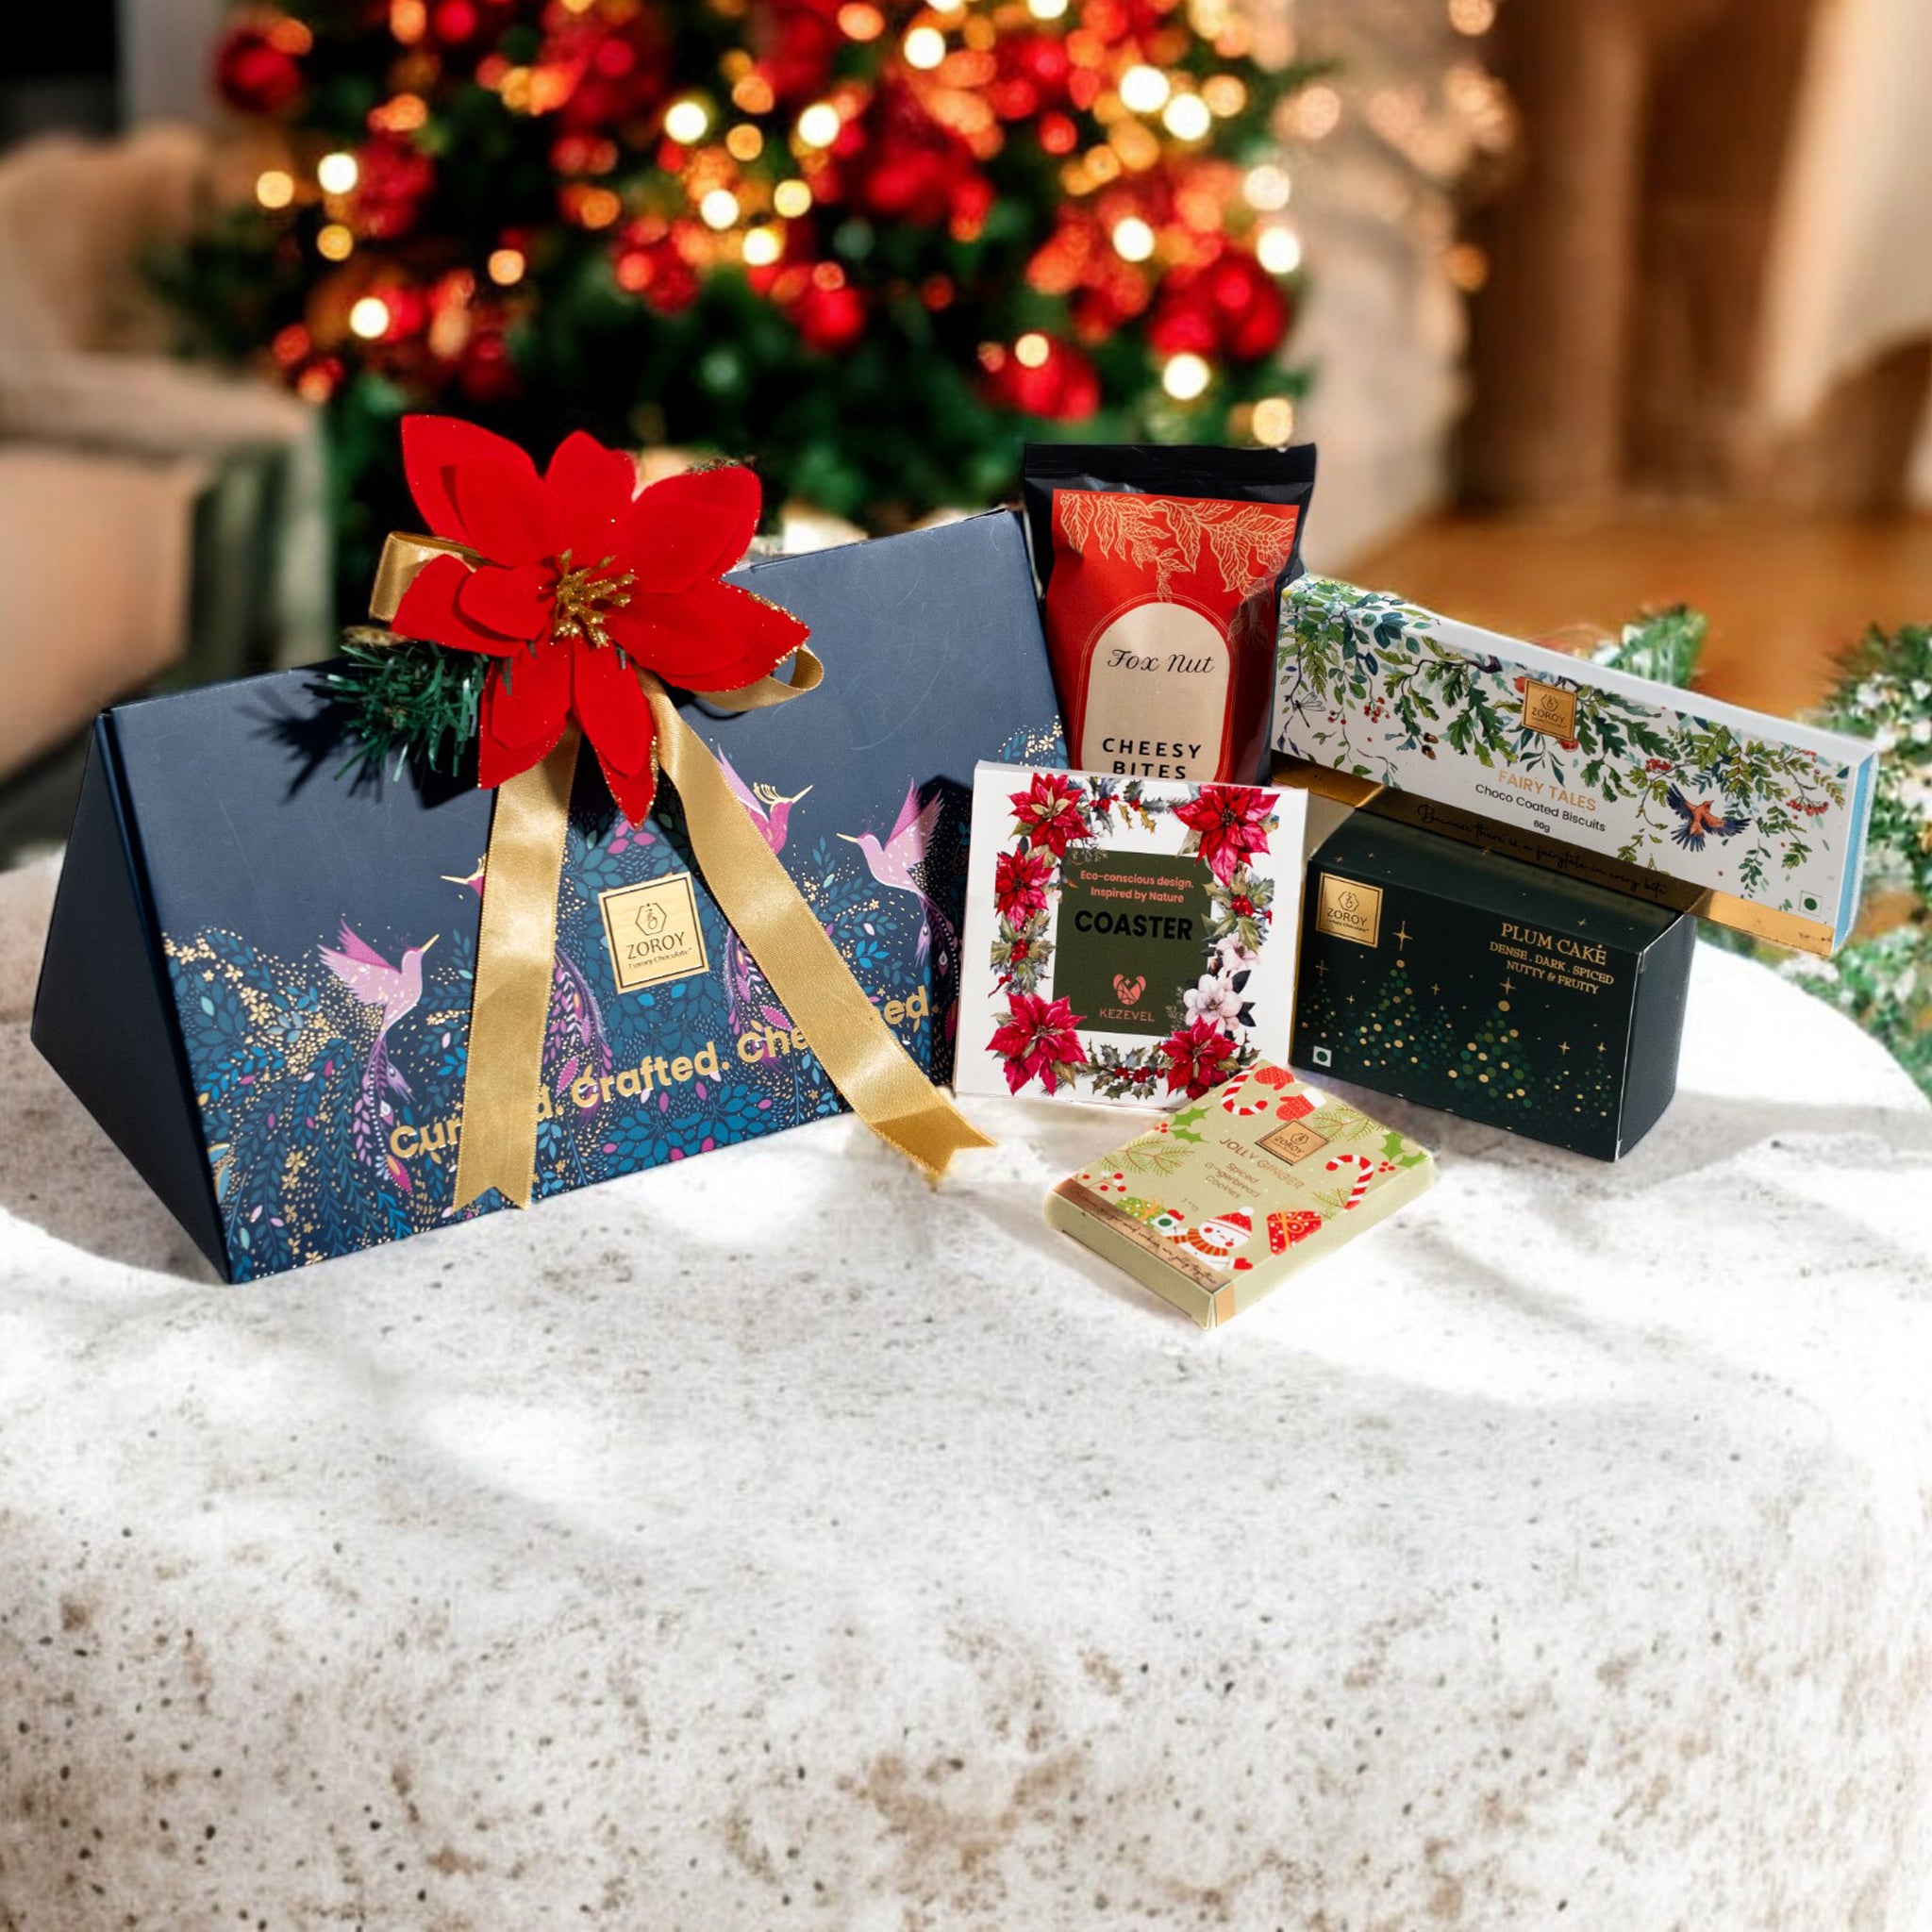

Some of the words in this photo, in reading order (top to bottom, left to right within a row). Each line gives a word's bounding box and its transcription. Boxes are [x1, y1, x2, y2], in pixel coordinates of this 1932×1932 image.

[1108, 649, 1160, 672] Fox
[1167, 654, 1215, 674] Nut
[1531, 707, 1566, 724] ZOROY
[1102, 738, 1202, 759] CHEESY
[1112, 760, 1187, 780] BITES
[1497, 770, 1544, 794] FAIRY
[1549, 785, 1596, 811] TALES
[1474, 784, 1513, 803] Choco
[1516, 796, 1559, 818] Coated
[1562, 811, 1606, 832] Biscuits
[1079, 870, 1156, 886] Eco-conscious
[1157, 875, 1194, 891] design.
[1091, 887, 1133, 900] Inspired
[1134, 890, 1148, 903] by
[1149, 891, 1185, 903] Nature
[1074, 909, 1193, 941] COASTER
[1327, 907, 1368, 926] ZOROY
[625, 930, 685, 960] ZOROY
[1501, 922, 1553, 950] PLUM
[1506, 959, 1546, 979] NUTTY
[1547, 972, 1557, 983] &
[1535, 954, 1566, 972] DARK
[1573, 965, 1615, 985] SPICED
[1099, 1008, 1155, 1023] KEZEVEL
[571, 1041, 730, 1109] Crafted.
[1219, 1138, 1258, 1160] JOLLY
[1257, 1159, 1305, 1190] GINGER
